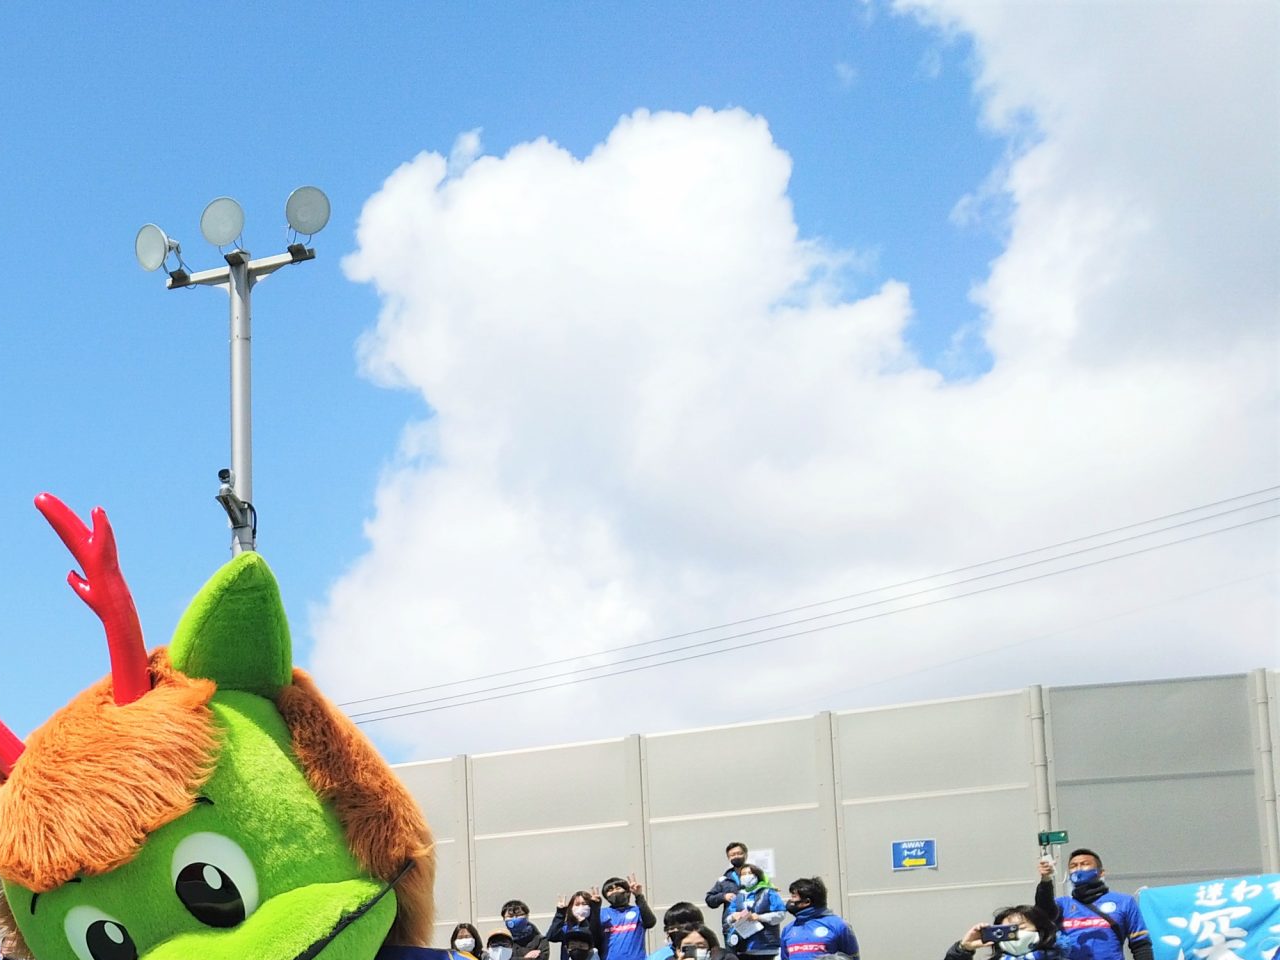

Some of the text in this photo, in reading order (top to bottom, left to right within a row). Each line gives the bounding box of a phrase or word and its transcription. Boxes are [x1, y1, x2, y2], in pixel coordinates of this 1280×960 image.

[901, 841, 926, 849] AWAY
[903, 848, 926, 856] トイレ
